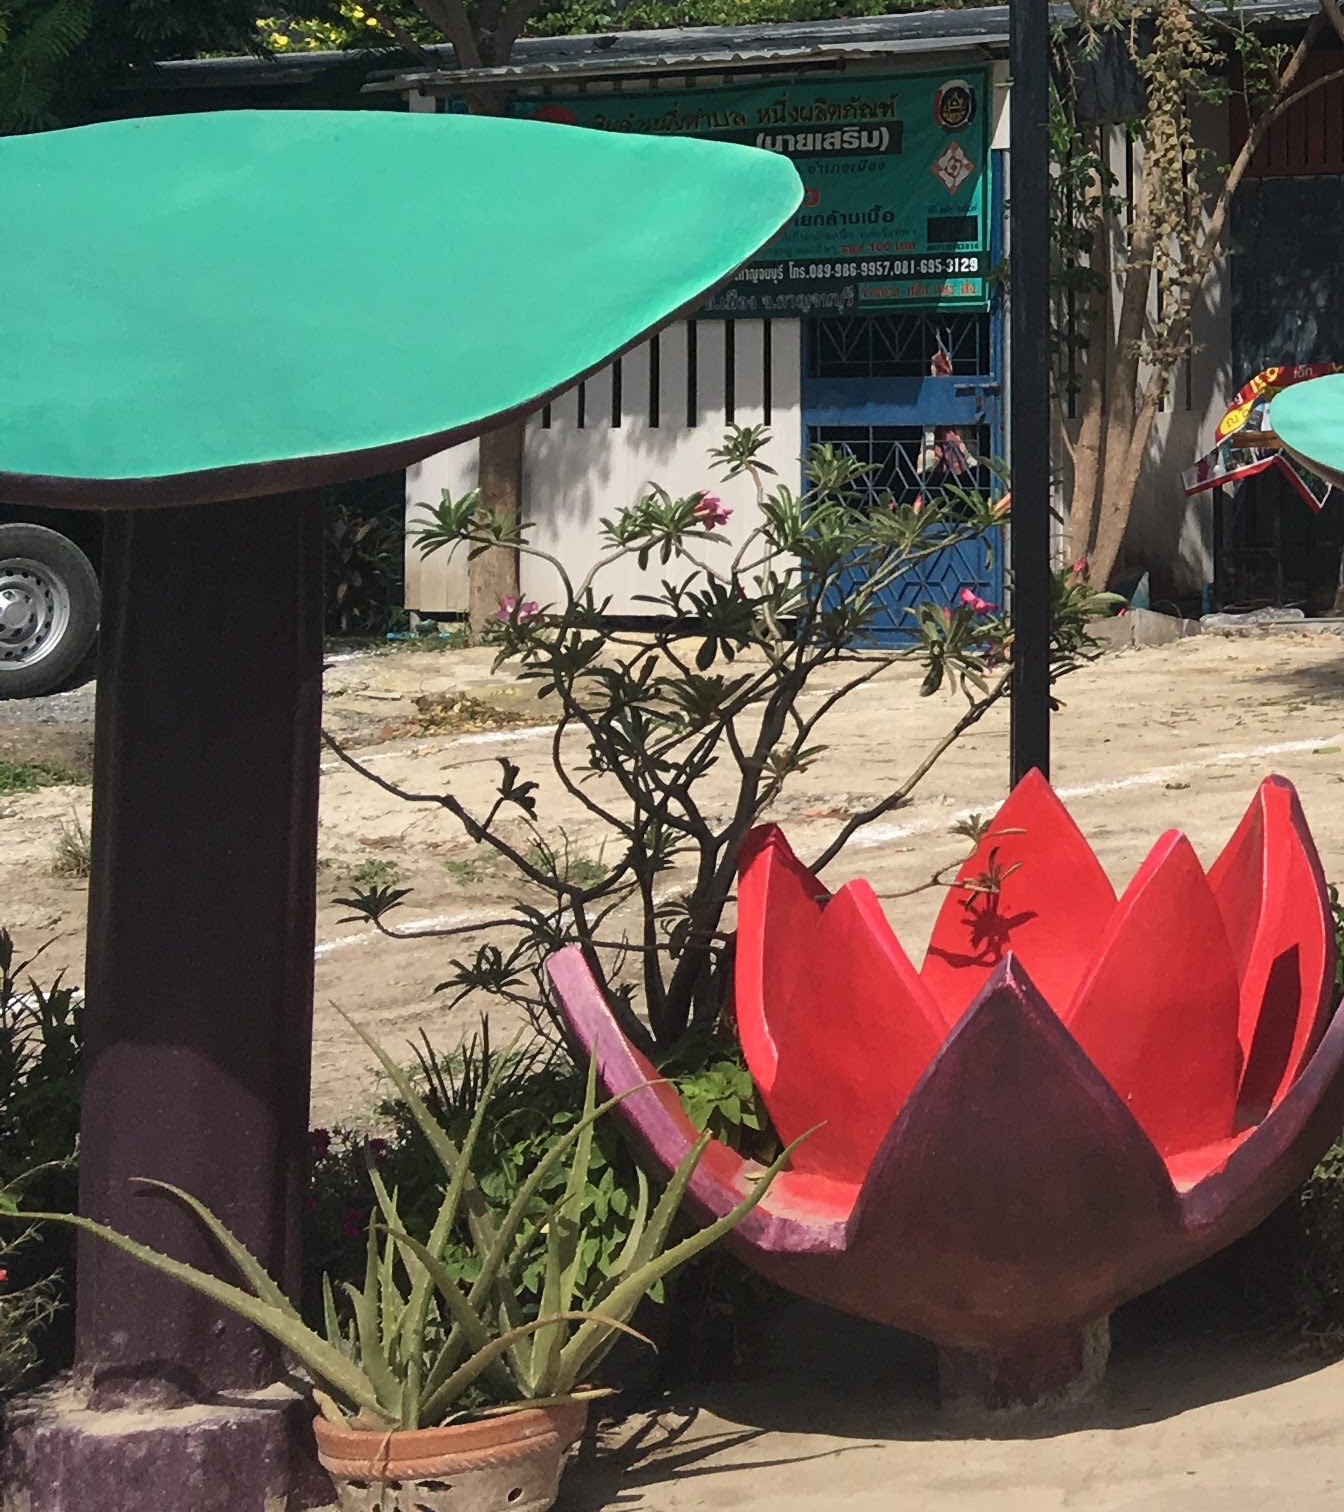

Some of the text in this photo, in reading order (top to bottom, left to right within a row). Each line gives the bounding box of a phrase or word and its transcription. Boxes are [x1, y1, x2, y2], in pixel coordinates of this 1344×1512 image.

[756, 92, 899, 125] หนึ่งผลิตภัณฑ์
[756, 126, 890, 152] (นายเสริม)
[735, 264, 783, 284] .กาญจนบุรี
